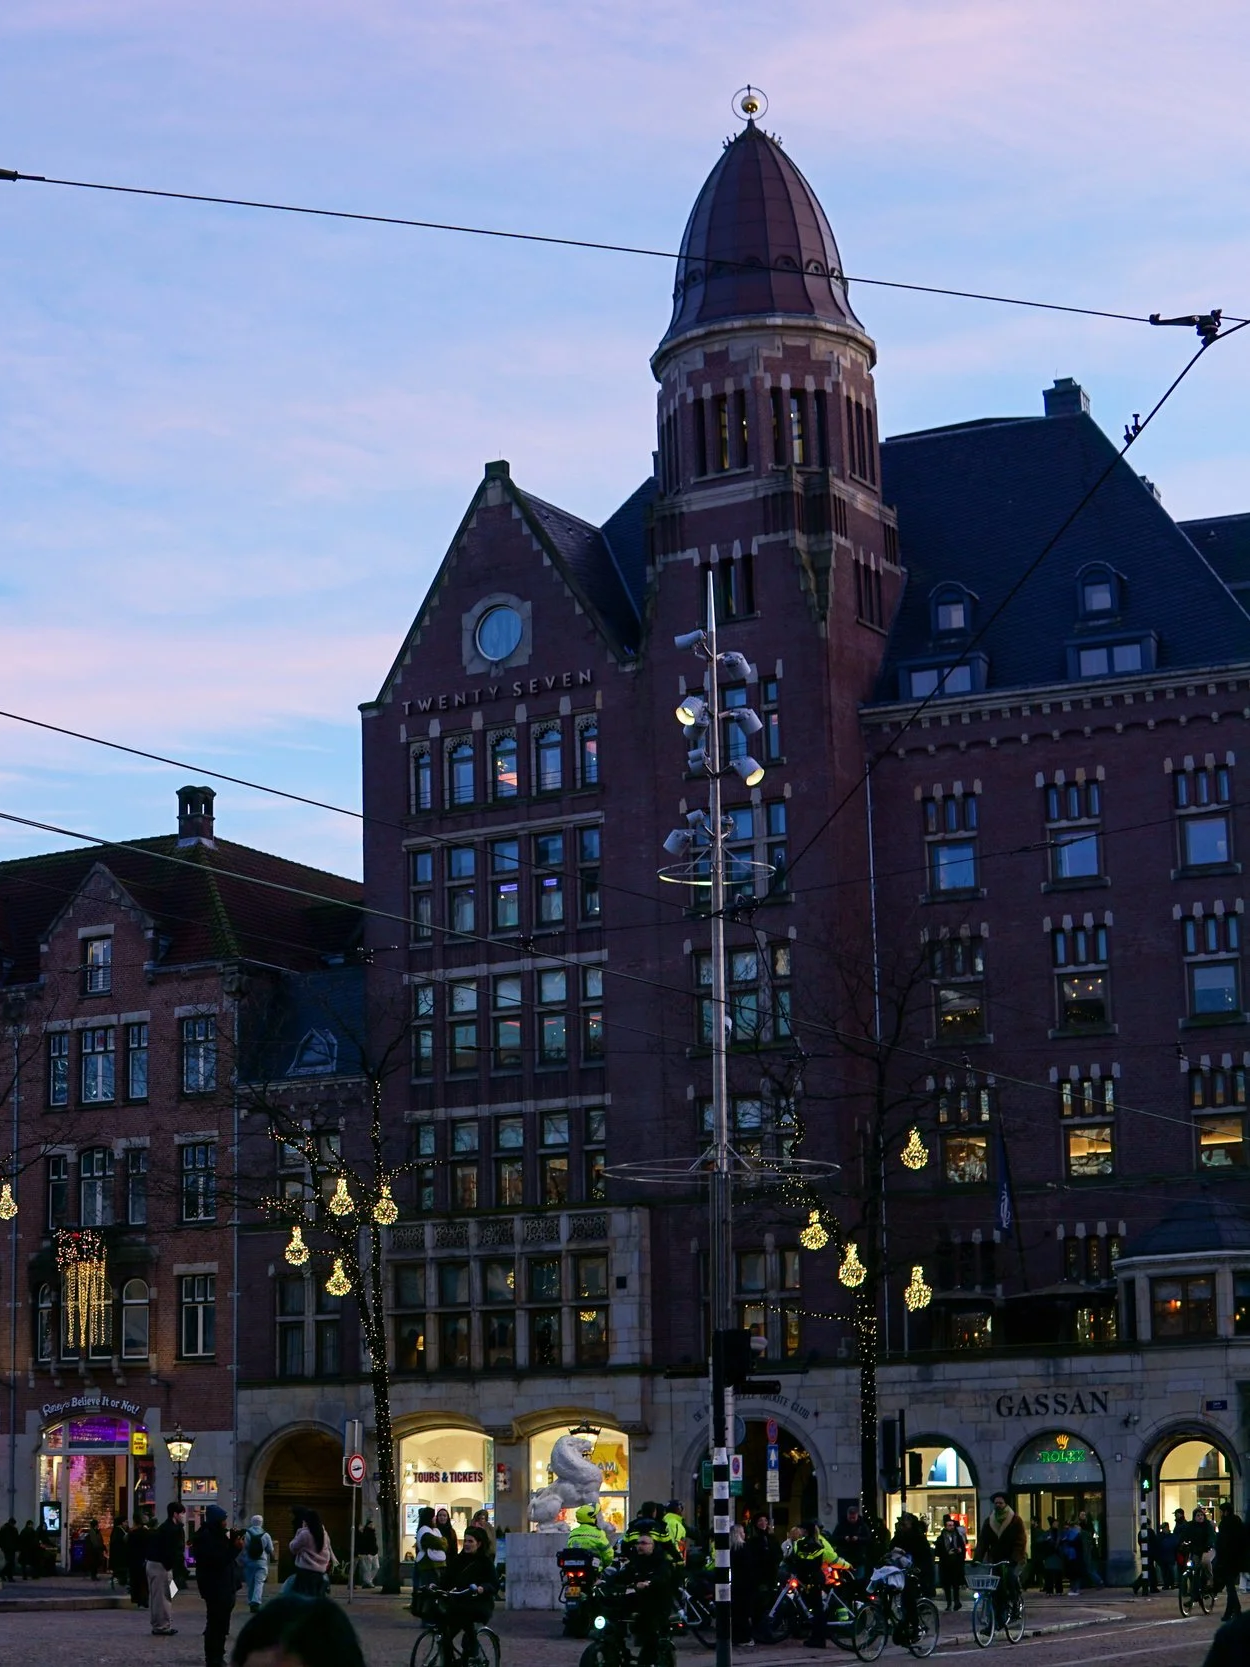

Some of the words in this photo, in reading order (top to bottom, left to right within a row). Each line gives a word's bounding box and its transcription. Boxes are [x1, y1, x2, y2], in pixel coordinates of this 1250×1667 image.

[402, 685, 499, 716] TWENTY
[513, 669, 592, 697] SEVEN
[71, 1396, 101, 1408] Believe
[102, 1395, 110, 1406] It
[111, 1400, 120, 1408] or
[121, 1400, 140, 1415] Not!
[790, 1401, 811, 1420] CLUB
[996, 1389, 1109, 1418] GASSAN
[1039, 1449, 1086, 1464] ROLEX
[412, 1471, 440, 1483] TOURS
[442, 1471, 449, 1483] &
[449, 1471, 484, 1483] TICKETS
